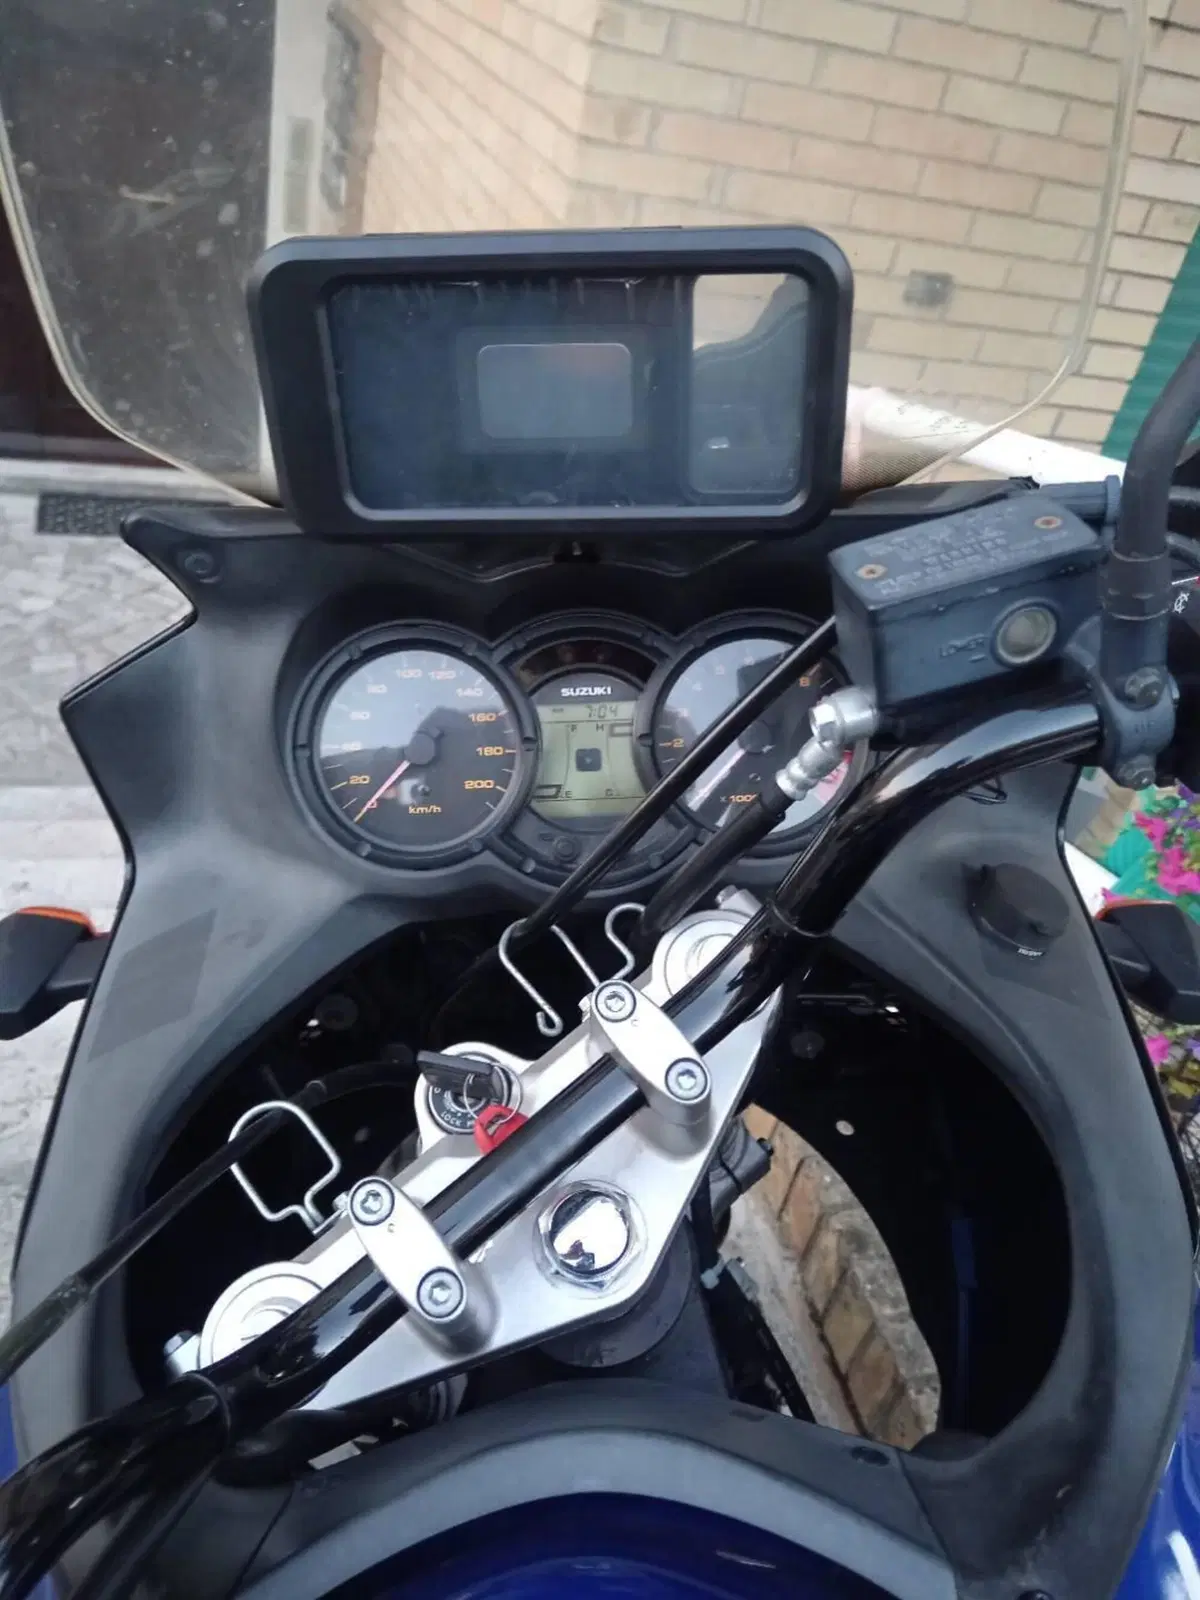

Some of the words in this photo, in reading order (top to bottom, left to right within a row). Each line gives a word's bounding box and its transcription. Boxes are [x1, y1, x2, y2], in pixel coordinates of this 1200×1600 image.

[560, 686, 612, 697] SUZUKI
[584, 703, 618, 719] 7:04
[468, 712, 497, 722] 160
[596, 723, 604, 732] H
[673, 738, 685, 748] 2
[476, 746, 504, 756] 180
[350, 775, 371, 785] 20
[464, 779, 495, 790] 200
[408, 805, 442, 816] km/h
[440, 1110, 460, 1127] LOCK
